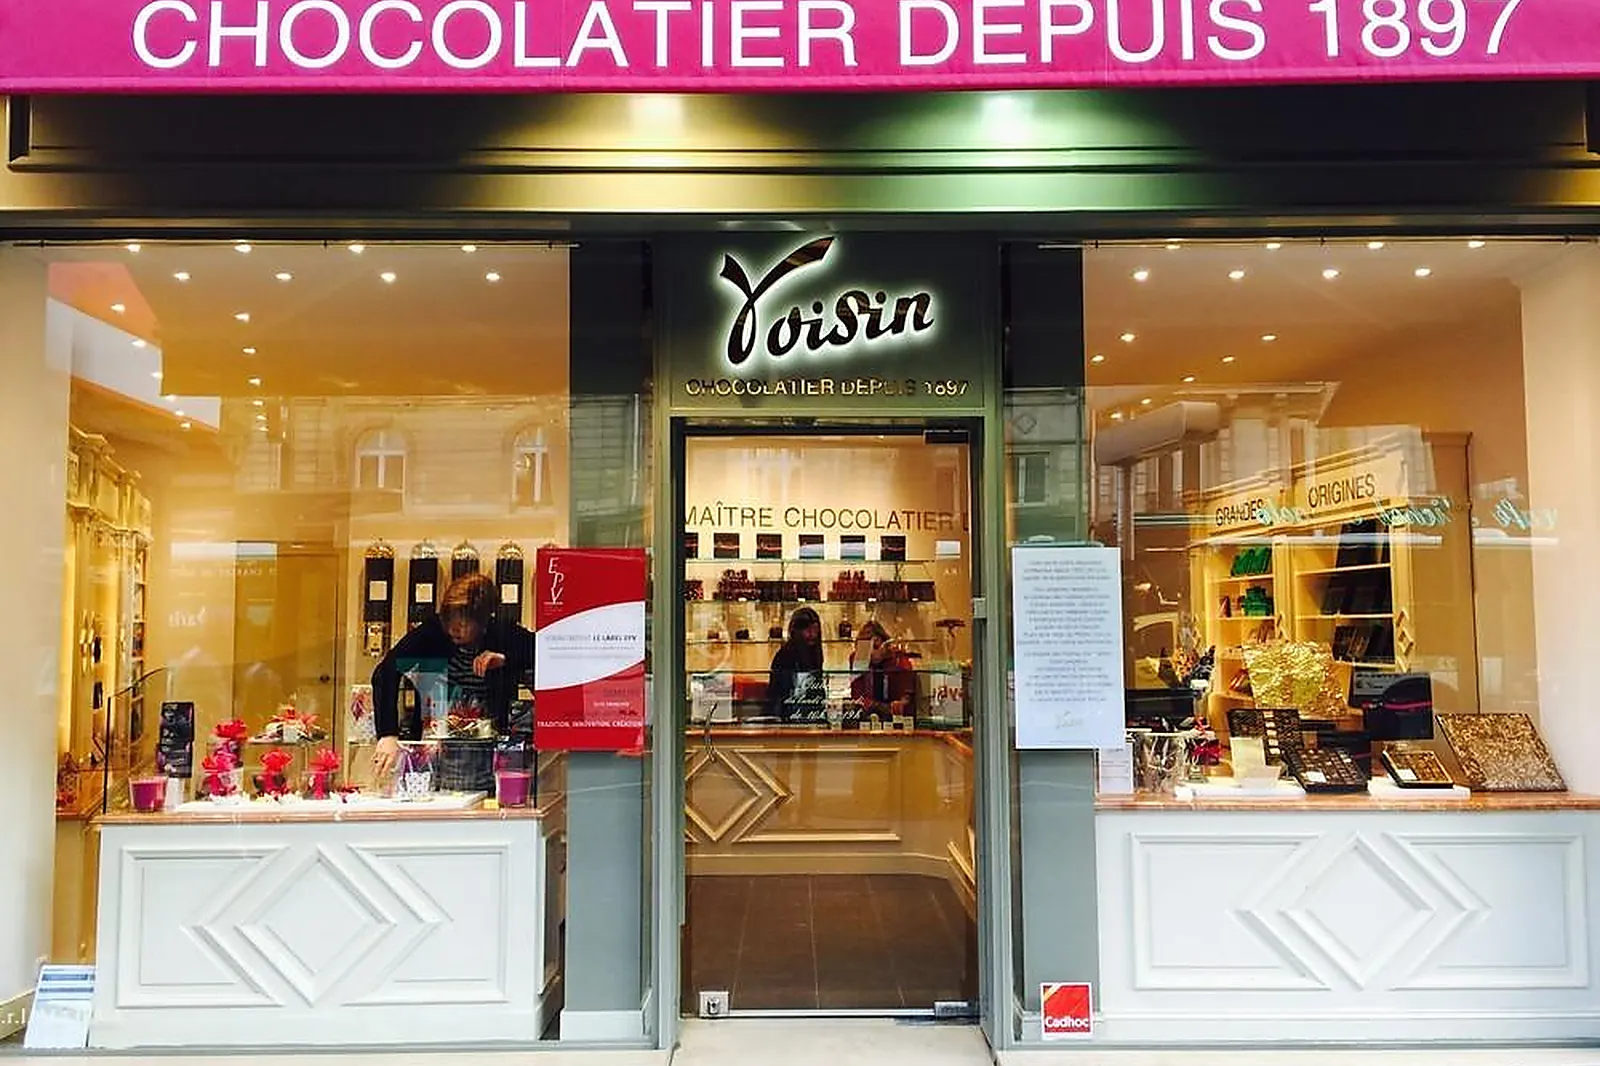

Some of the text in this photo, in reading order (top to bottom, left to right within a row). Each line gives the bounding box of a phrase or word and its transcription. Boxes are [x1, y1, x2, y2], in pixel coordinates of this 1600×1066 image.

[132, 0, 1522, 68] CHOCOLATIER DEPUIS 1897
[719, 236, 934, 366] Voisin
[685, 378, 969, 397] CHOCOLATIER DEPUIS 1897
[784, 506, 954, 533] CHOCOLATIER
[1215, 498, 1265, 527] GRANDES
[1307, 473, 1375, 509] ORIGINES
[1045, 1015, 1089, 1029] Cadhoc
